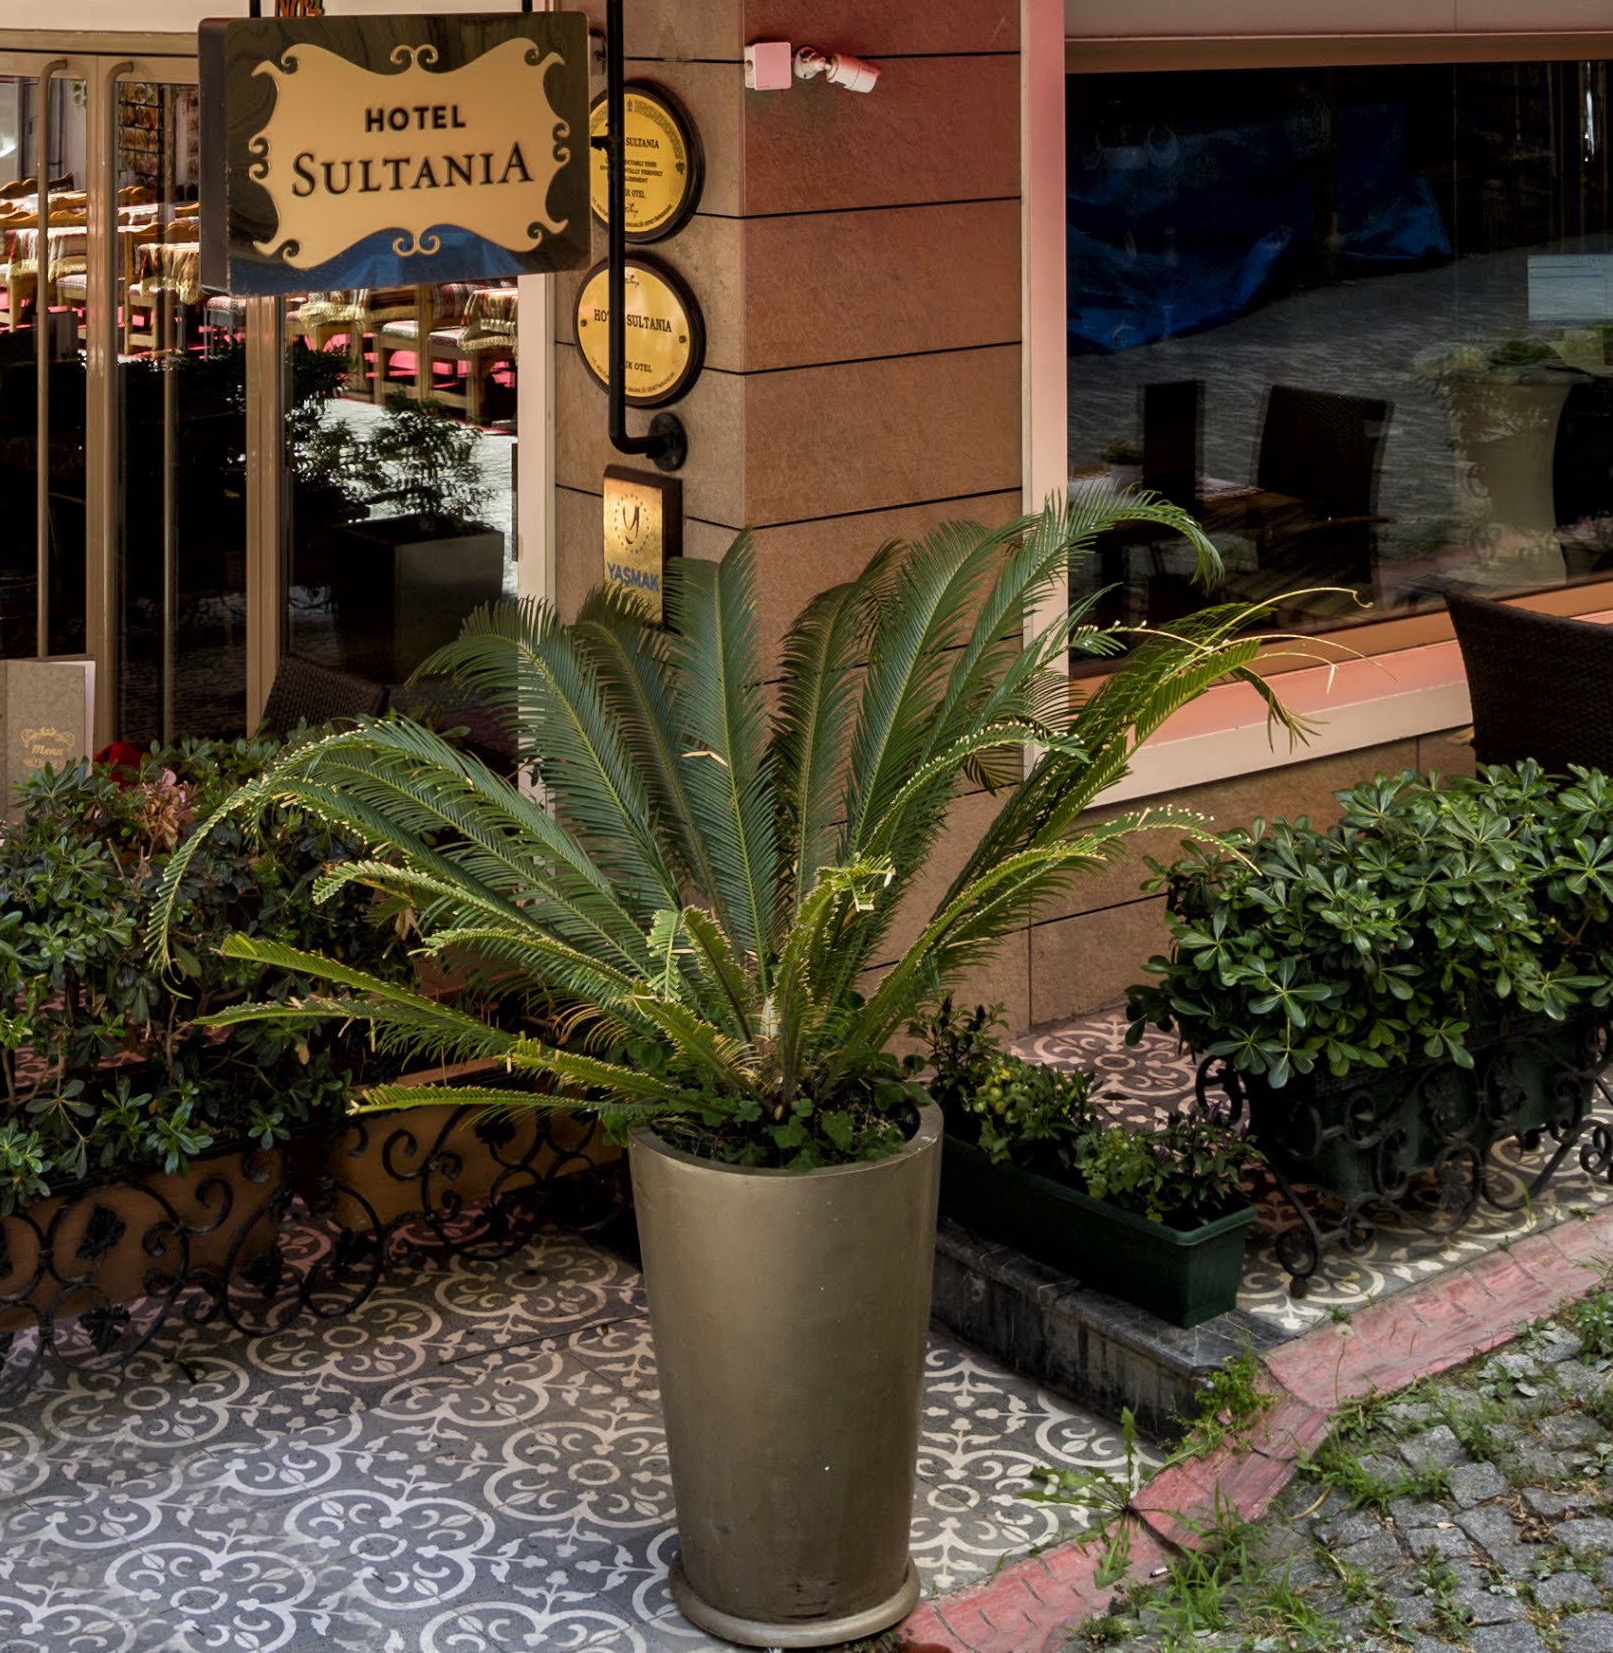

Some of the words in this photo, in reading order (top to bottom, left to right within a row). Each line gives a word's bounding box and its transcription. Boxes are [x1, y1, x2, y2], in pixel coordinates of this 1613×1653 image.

[365, 104, 466, 133] HOTEL
[625, 137, 659, 149] SULTANIA
[291, 141, 534, 198] SULTANIA
[627, 314, 672, 333] SULTANIA
[634, 362, 653, 373] OTEL
[31, 743, 64, 757] Menu
